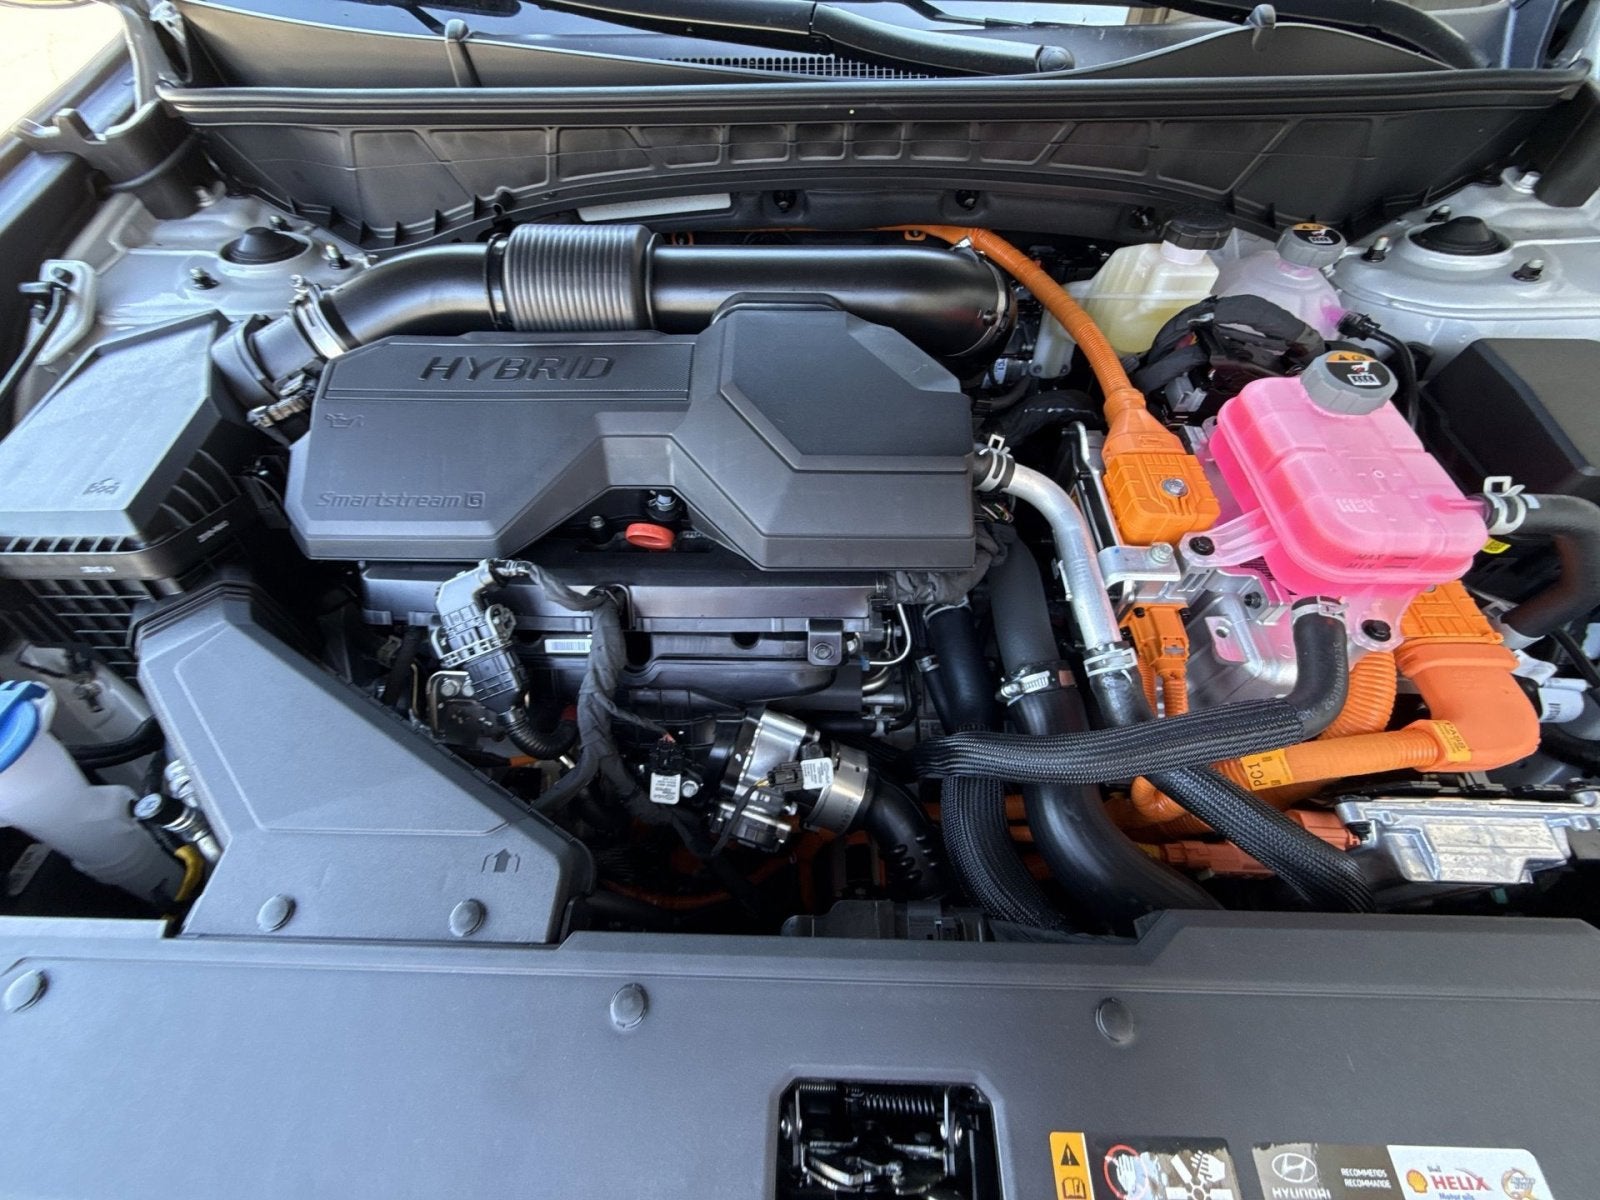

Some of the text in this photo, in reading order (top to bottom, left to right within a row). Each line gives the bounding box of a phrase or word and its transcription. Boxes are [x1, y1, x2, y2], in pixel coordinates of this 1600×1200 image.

[418, 356, 616, 381] HYBRID
[316, 490, 486, 508] Smartstream G
[1355, 553, 1385, 561] MAX
[1247, 762, 1268, 787] PC1
[1340, 1167, 1388, 1178] RECOMMENDS
[1431, 1175, 1492, 1191] HELIX
[1271, 1187, 1332, 1199] HYUNDAI
